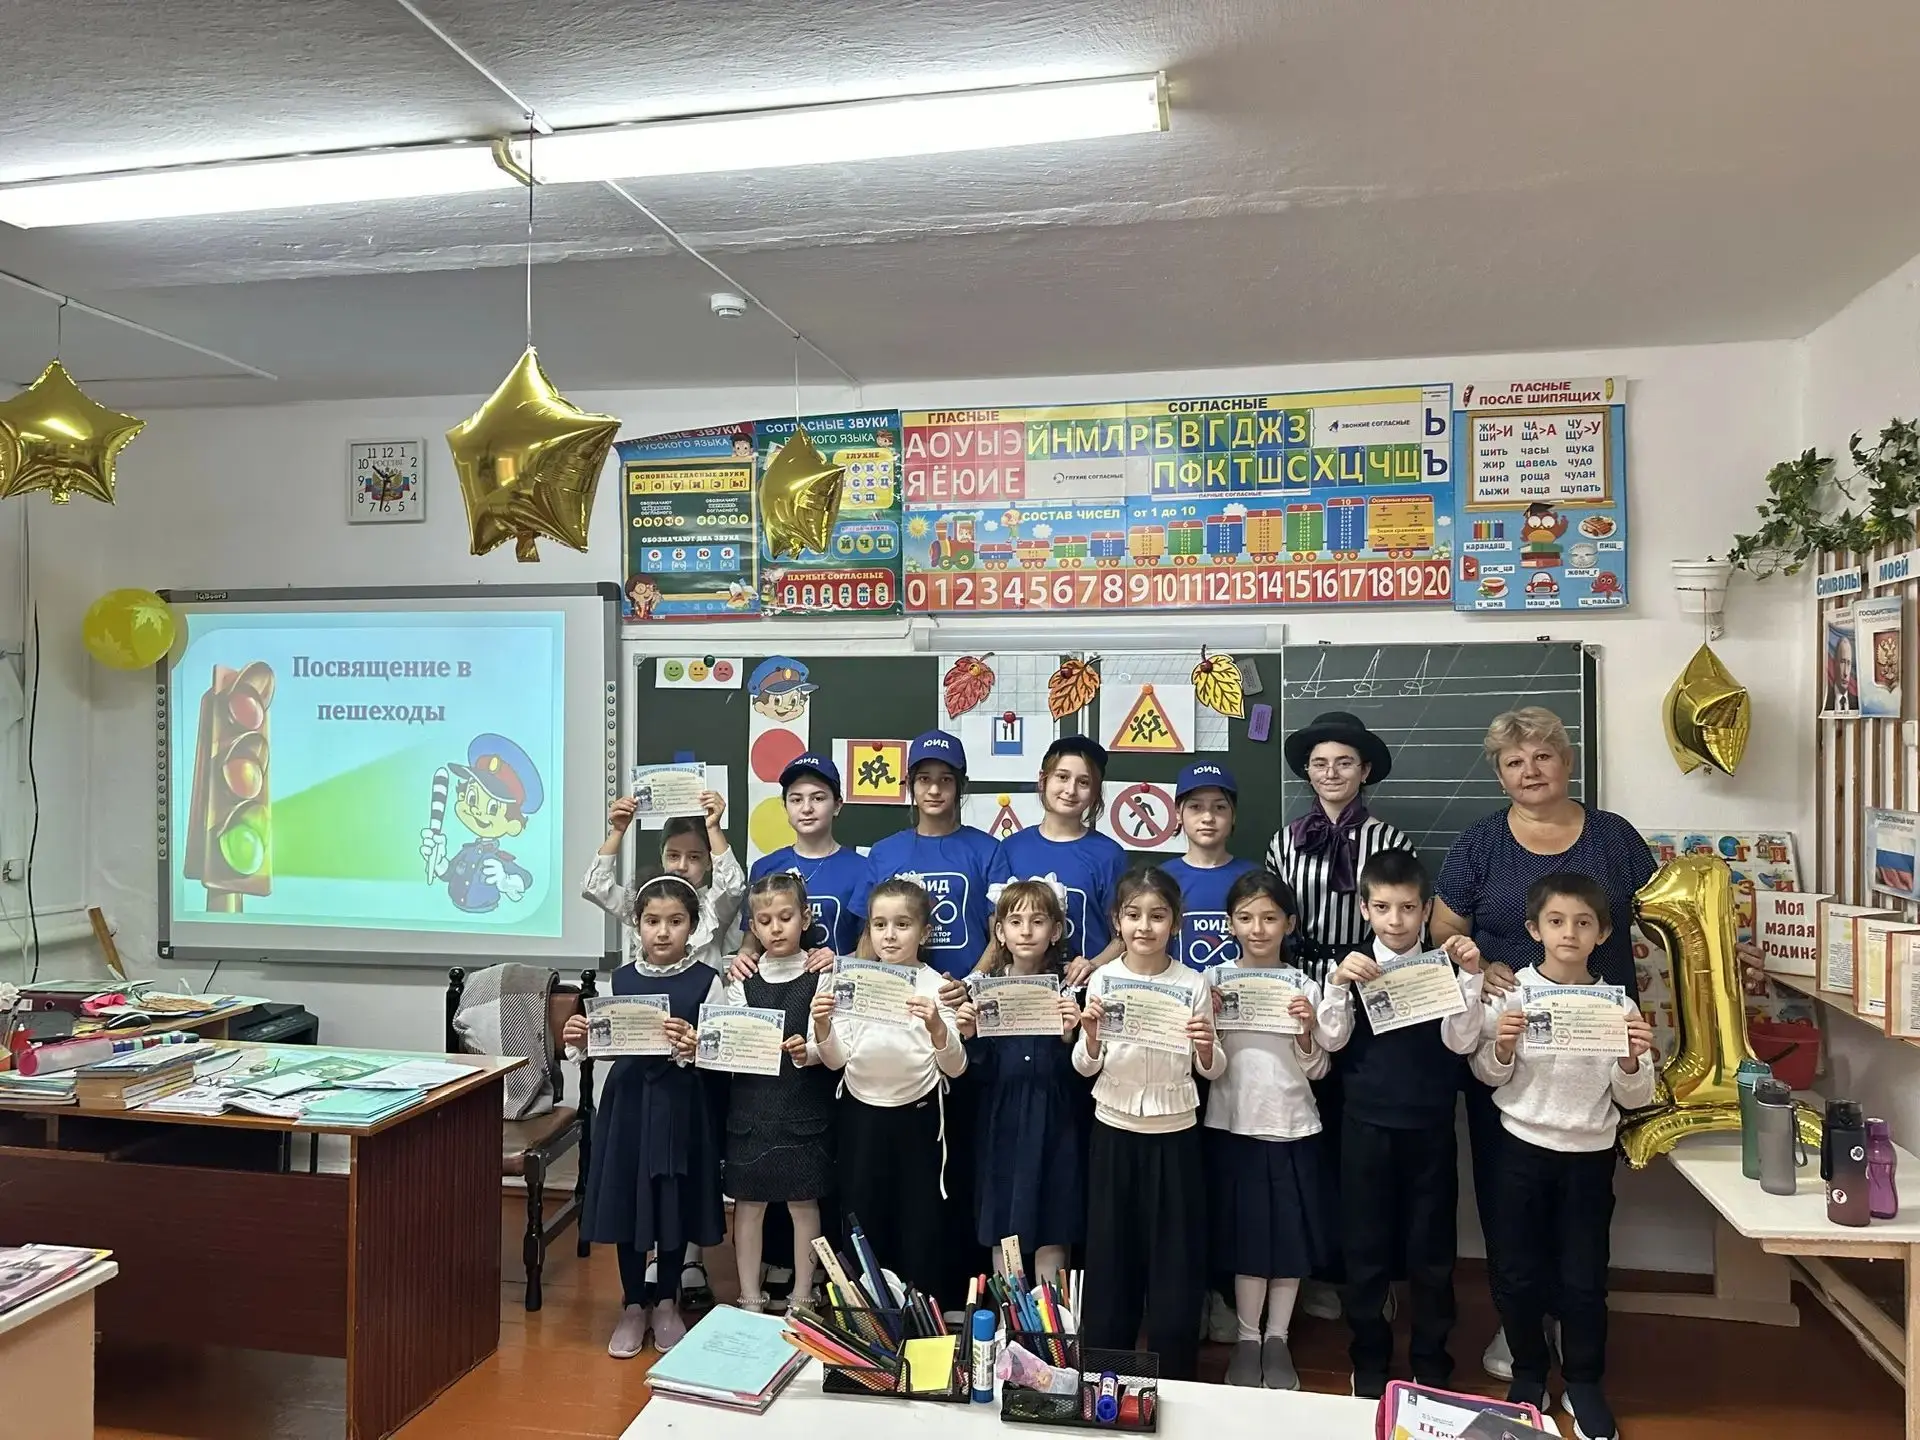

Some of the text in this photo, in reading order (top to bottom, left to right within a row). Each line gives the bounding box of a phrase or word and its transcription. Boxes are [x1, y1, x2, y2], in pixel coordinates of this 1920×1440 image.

[1510, 381, 1571, 393] ГЛАСНЫЕ
[1479, 391, 1601, 405] ПОСЛЕ ШИПЯЩИХ
[1168, 398, 1267, 413] СОГЛАСНЫЕ
[928, 410, 999, 424] ГЛАСНЫЕ
[1372, 418, 1410, 427] СОГЛАСНЫЕ
[1425, 407, 1445, 436] Ь
[766, 416, 888, 434] СОГЛАСНЫЕ ЗВУКИ
[1479, 423, 1496, 432] ЖИ
[1524, 421, 1538, 431] ЧА
[1567, 419, 1582, 429] ЧУ
[695, 424, 742, 437] ЗВУКИ
[906, 414, 1305, 458] А О У Ы Э Й Н М Л Р Б В Г Д Ж З
[1565, 430, 1583, 441] ЩУ
[784, 433, 875, 445] РКОГО ЯЗЫКА
[1479, 433, 1496, 441] ШИ
[1521, 432, 1539, 441] ЩА
[637, 438, 729, 451] РУССКОГО ЯЗЫКА
[1521, 446, 1549, 454] часы
[1565, 445, 1595, 454] щука
[368, 448, 377, 459] 11
[382, 447, 394, 458] 12
[400, 447, 405, 458] 1
[846, 451, 880, 459] ГЛУХИЕ
[1480, 448, 1508, 457] шить
[358, 459, 369, 470] 10
[410, 457, 417, 467] 2
[1424, 449, 1447, 476] Ъ
[1483, 460, 1505, 470] жир
[1516, 459, 1557, 468] щавель
[1567, 457, 1592, 467] чудо
[1154, 450, 1419, 488] П Ф К Т Ш С Х Ц Ч Щ
[358, 475, 365, 486] 9
[411, 473, 417, 485] 3
[907, 465, 1020, 496] Я Ё Ю И Е
[1480, 474, 1509, 482] шина
[1521, 473, 1550, 482] роща
[1564, 470, 1595, 480] чулан
[1479, 487, 1509, 496] лыжи
[1521, 486, 1550, 495] чаща
[1560, 484, 1601, 494] щупать
[357, 493, 365, 503] 8
[410, 492, 417, 501] 4
[369, 502, 376, 512] 7
[383, 502, 391, 512] 6
[398, 501, 405, 512] 5
[1021, 506, 1196, 520] СОСТАВ ЧИСЕЛ от 1 до 10
[641, 535, 695, 543] ОБОЗНАЧАЮТ
[1879, 554, 1908, 582] моей
[787, 572, 884, 581] ПАРНЫЕ СОГЛАСНЫЕ
[908, 566, 1451, 606] 0 1 2 3 4 5 6 7 8 9 10 11 12 13 14 15 16 17 18 19 20
[1816, 572, 1860, 596] Символы
[292, 656, 472, 682] Посвящение в
[317, 703, 446, 726] пешеходы
[923, 738, 950, 749] ЮИД
[1193, 765, 1221, 775] ЮИД
[1775, 900, 1804, 915] Моя
[1765, 922, 1815, 938] малая
